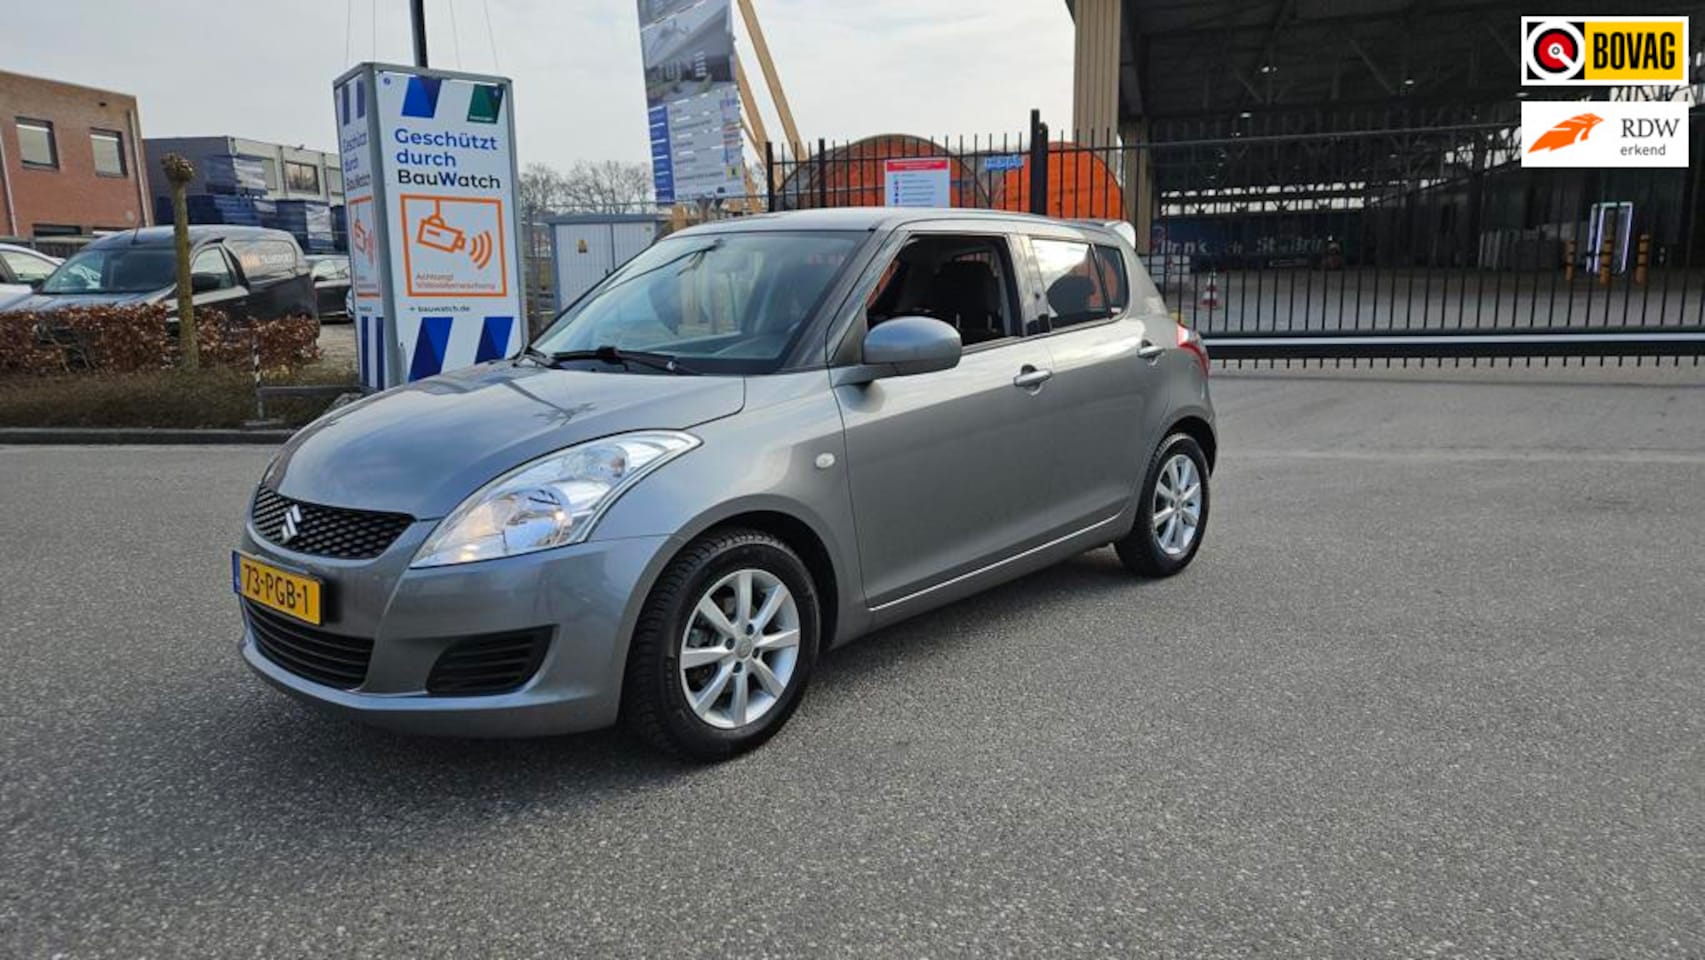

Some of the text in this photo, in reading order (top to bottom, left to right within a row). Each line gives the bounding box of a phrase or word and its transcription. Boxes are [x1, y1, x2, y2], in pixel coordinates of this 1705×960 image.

[394, 128, 499, 150] Geschützt
[396, 149, 457, 167] durch
[397, 169, 501, 189] BauWatch
[243, 563, 309, 615] 73-PGB-1
